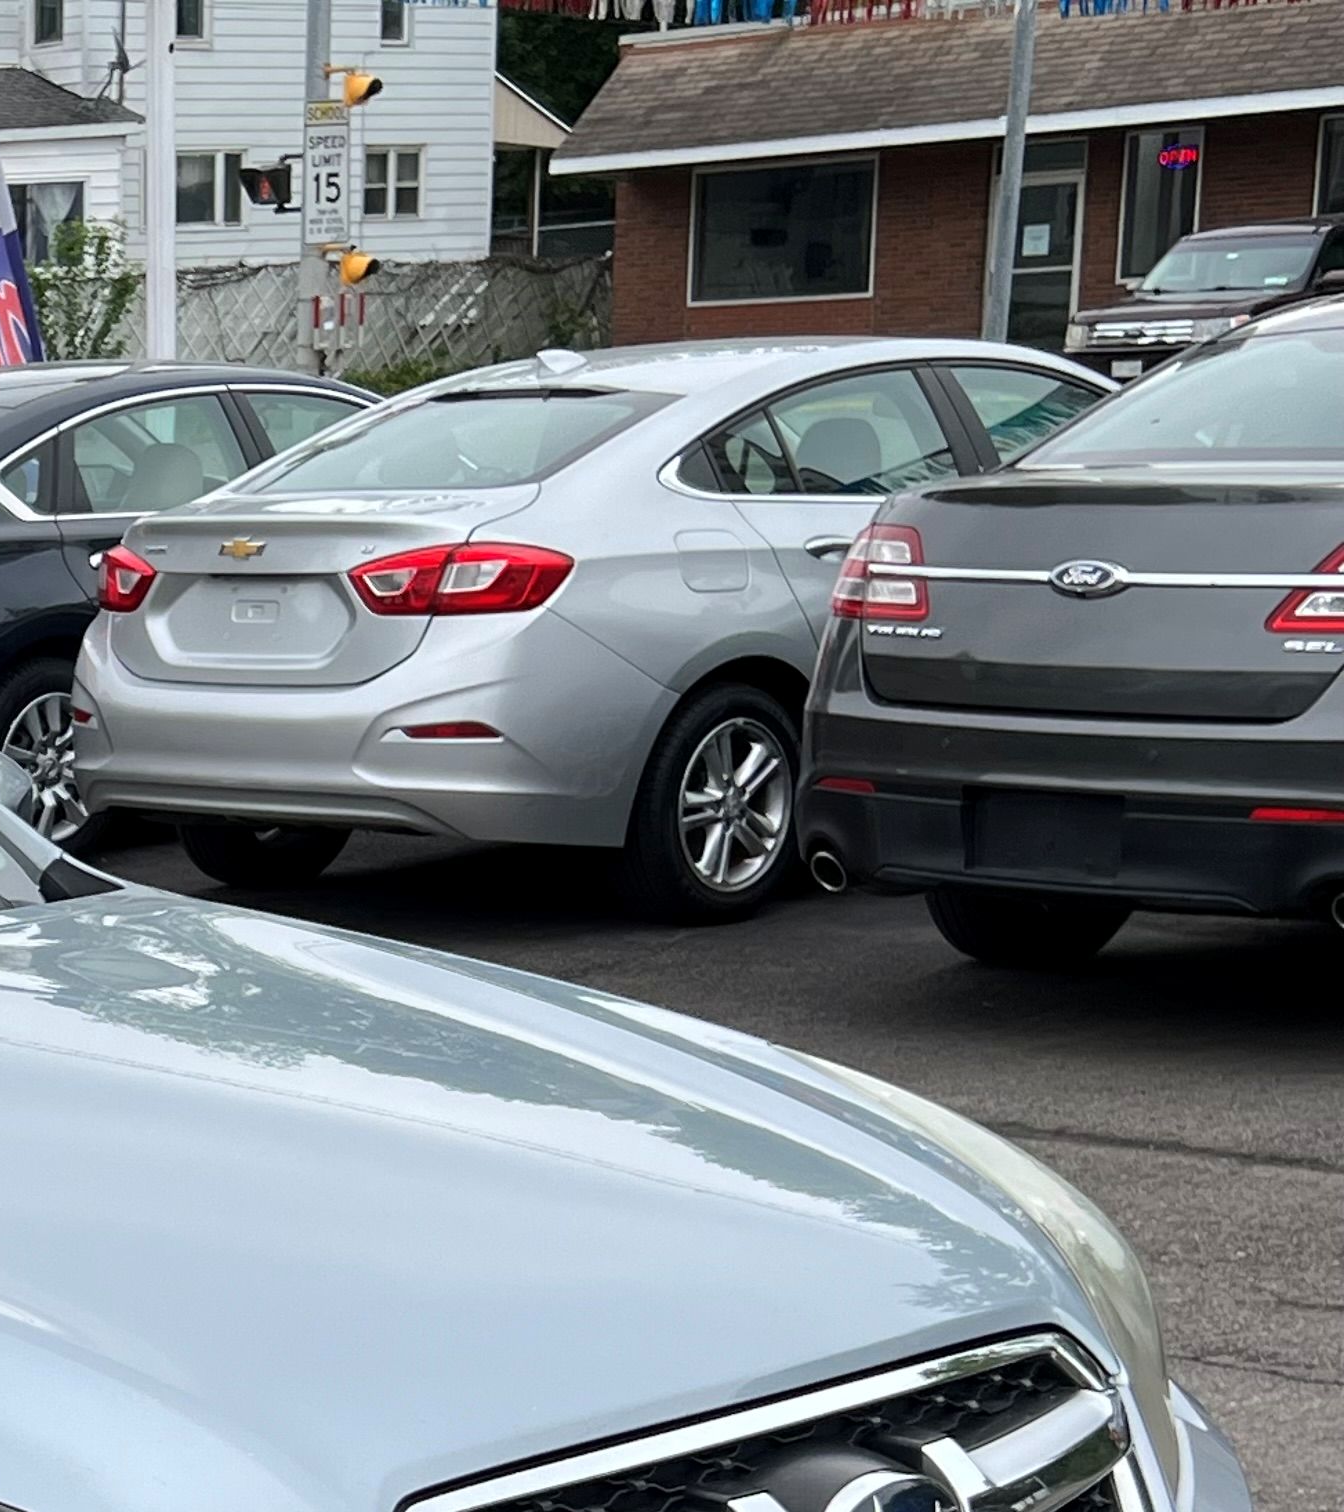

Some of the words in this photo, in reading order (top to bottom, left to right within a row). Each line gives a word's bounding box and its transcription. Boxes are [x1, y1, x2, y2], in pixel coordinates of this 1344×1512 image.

[307, 105, 349, 121] SCHOOL
[308, 135, 347, 150] SPEED
[312, 153, 342, 168] LIMIT
[314, 172, 341, 204] 15
